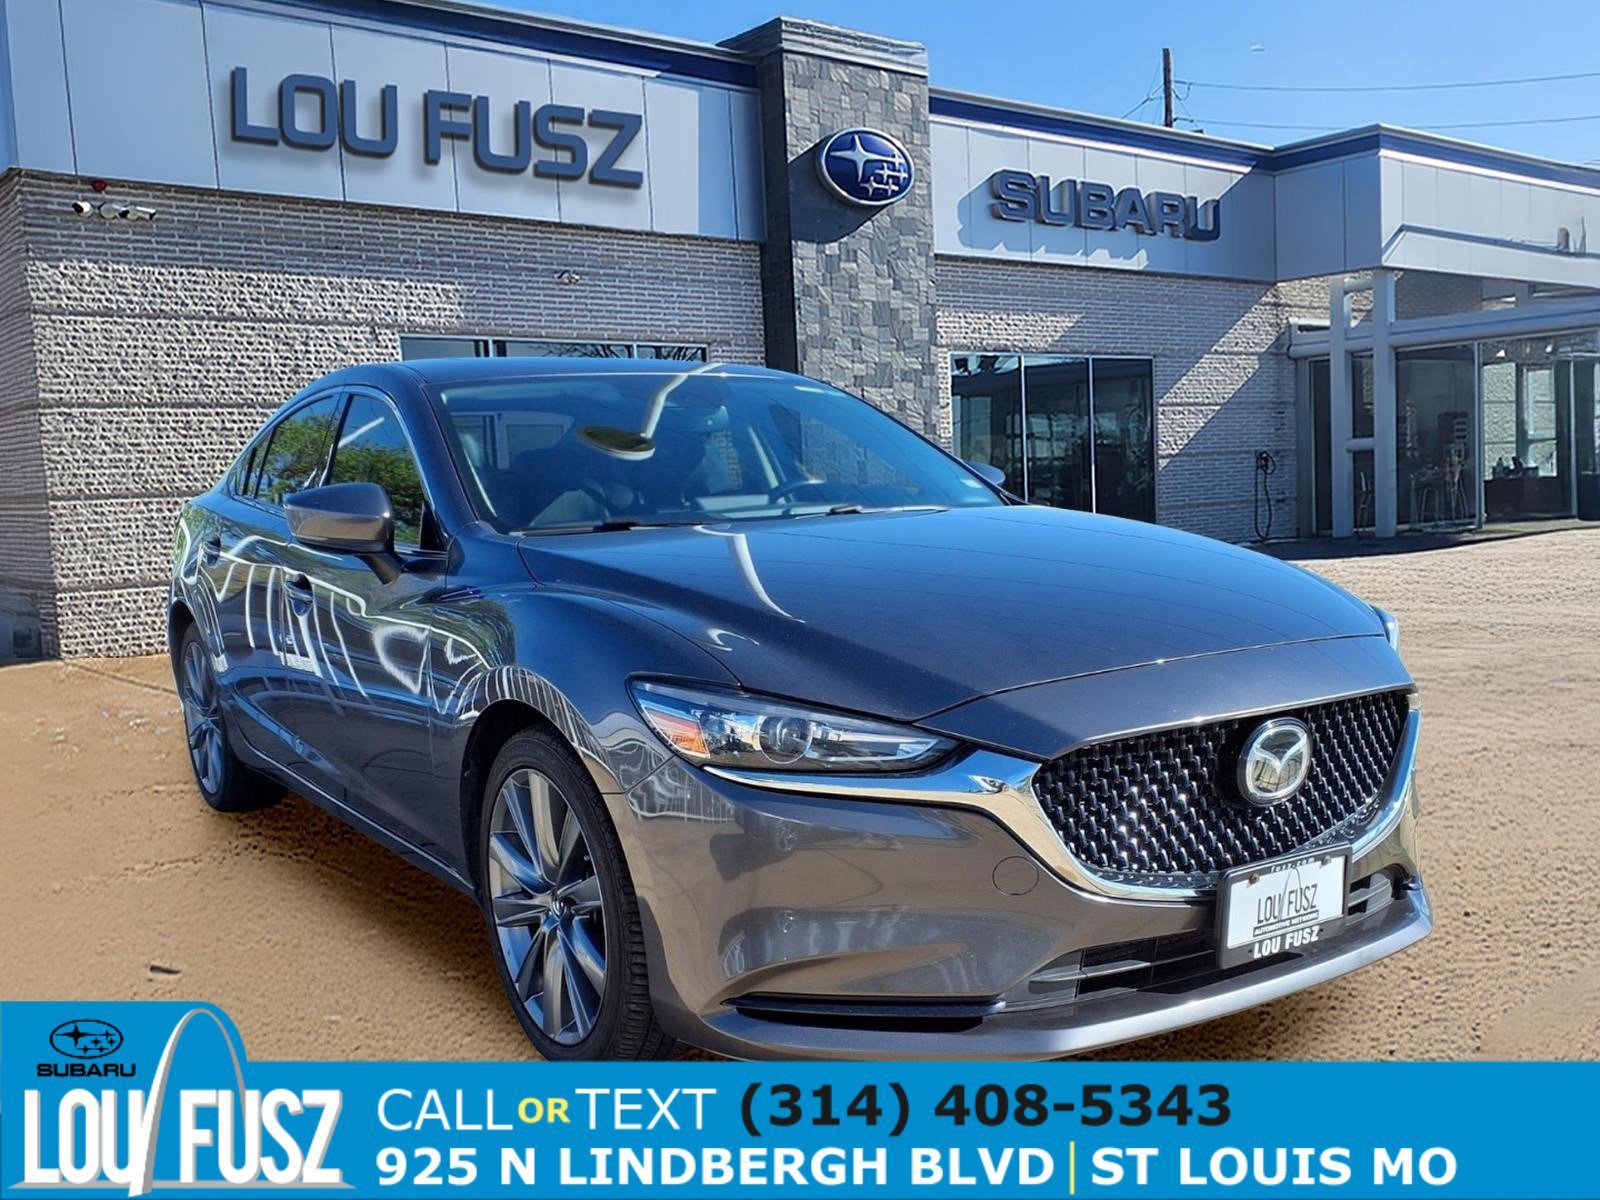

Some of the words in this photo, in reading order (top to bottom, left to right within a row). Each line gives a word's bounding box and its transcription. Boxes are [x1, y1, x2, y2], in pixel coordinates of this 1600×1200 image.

[230, 66, 398, 158] LOU
[424, 89, 644, 190] FUSZ
[991, 168, 1221, 242] SUBARU
[1257, 893, 1282, 924] LOU
[1286, 883, 1318, 917] FUSZ
[1253, 936, 1281, 959] LOU
[1285, 925, 1320, 949] FUSZ
